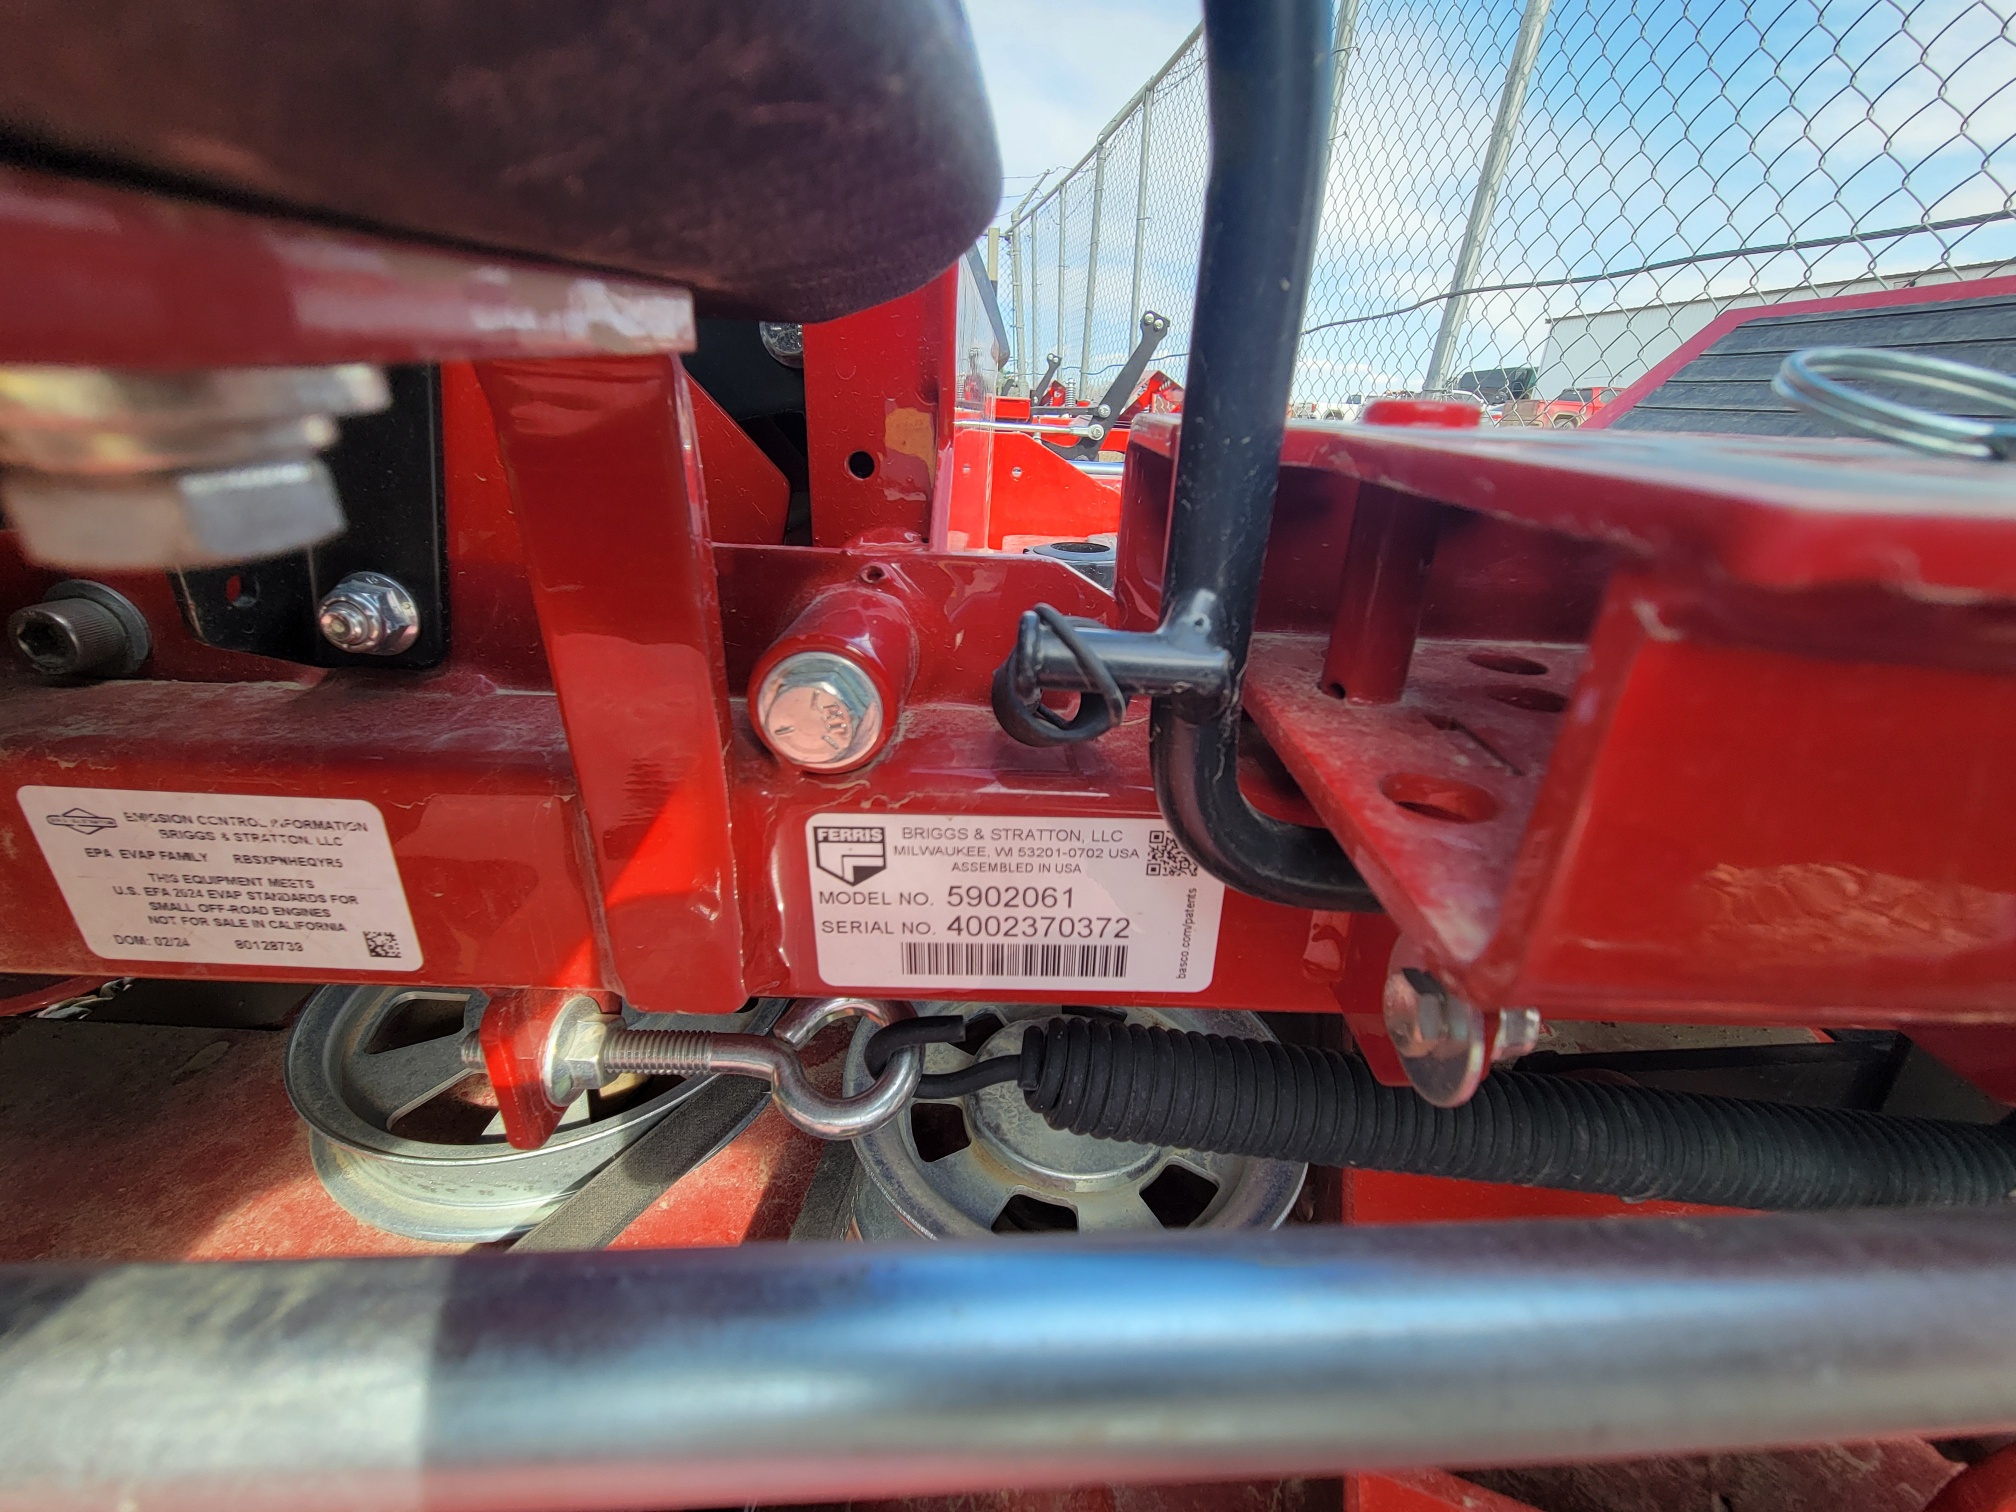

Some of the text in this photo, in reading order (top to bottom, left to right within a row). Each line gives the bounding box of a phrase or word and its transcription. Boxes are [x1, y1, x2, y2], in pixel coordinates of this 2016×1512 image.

[196, 814, 267, 828] CONTROL
[158, 829, 216, 841] BRIGGS
[316, 836, 343, 847] LLC
[817, 828, 883, 842] FERRIS
[902, 826, 1124, 844] BRIGGS & STRATTON, LLC
[84, 847, 114, 859] EPA
[118, 849, 156, 860] EVAP
[158, 850, 208, 863] FAMILY
[894, 845, 1140, 860] MILWAUKEE, WI 53201-0702 USA
[951, 861, 1082, 875] ASSEMBLED IN USA
[147, 872, 315, 889] THIS EQUIPMENT MEETS
[112, 885, 141, 897] U.S.
[206, 889, 242, 900] EVAP
[245, 890, 328, 904] STANDARDS
[330, 894, 360, 905] FOR
[819, 886, 1073, 908] MODEL NO. 5902061
[148, 901, 332, 918] SMALL OFF-ROAD ENGINES
[147, 915, 348, 932] NOT FOR SALE IN CALIFORNIA
[821, 916, 1130, 938] SERIAL NO. 4002370372
[1176, 887, 1197, 979] basco.com/patents
